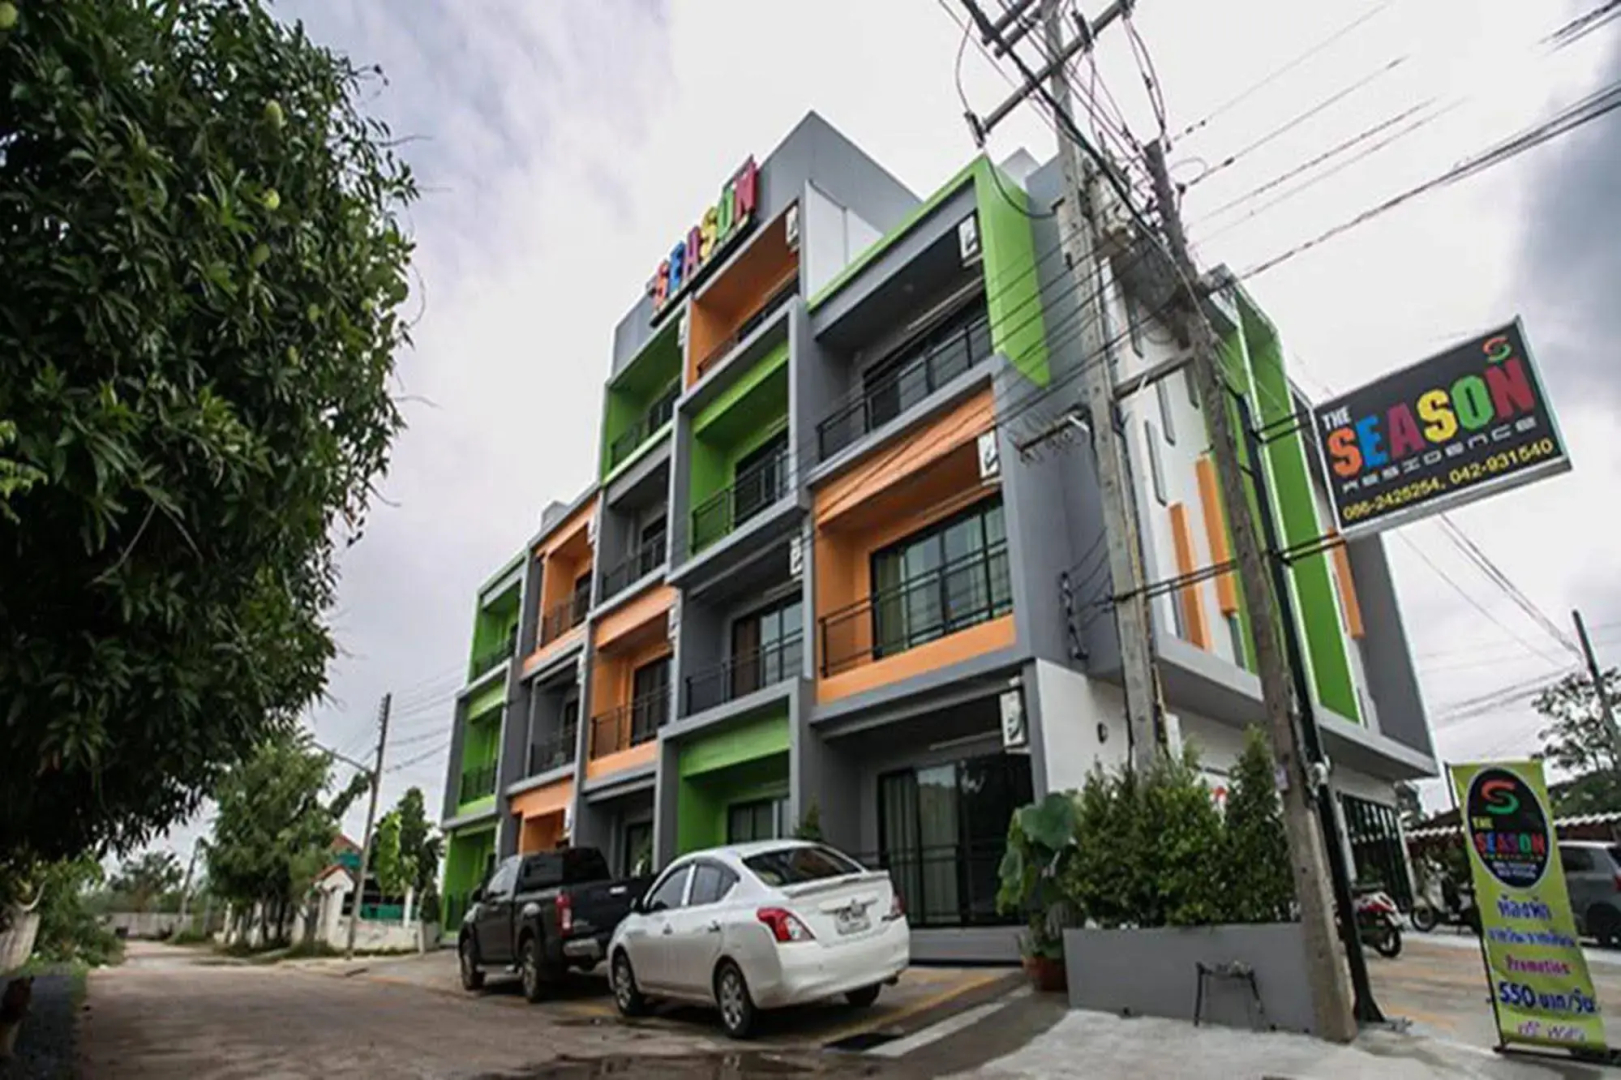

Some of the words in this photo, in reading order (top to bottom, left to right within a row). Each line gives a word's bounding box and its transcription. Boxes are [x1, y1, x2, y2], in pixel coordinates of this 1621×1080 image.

[653, 160, 758, 307] SEASON
[1322, 405, 1351, 431] THE
[1327, 356, 1536, 478] SEASON
[1472, 815, 1494, 830] THE
[1475, 831, 1546, 856] SEASON
[1499, 980, 1537, 1009] 550
